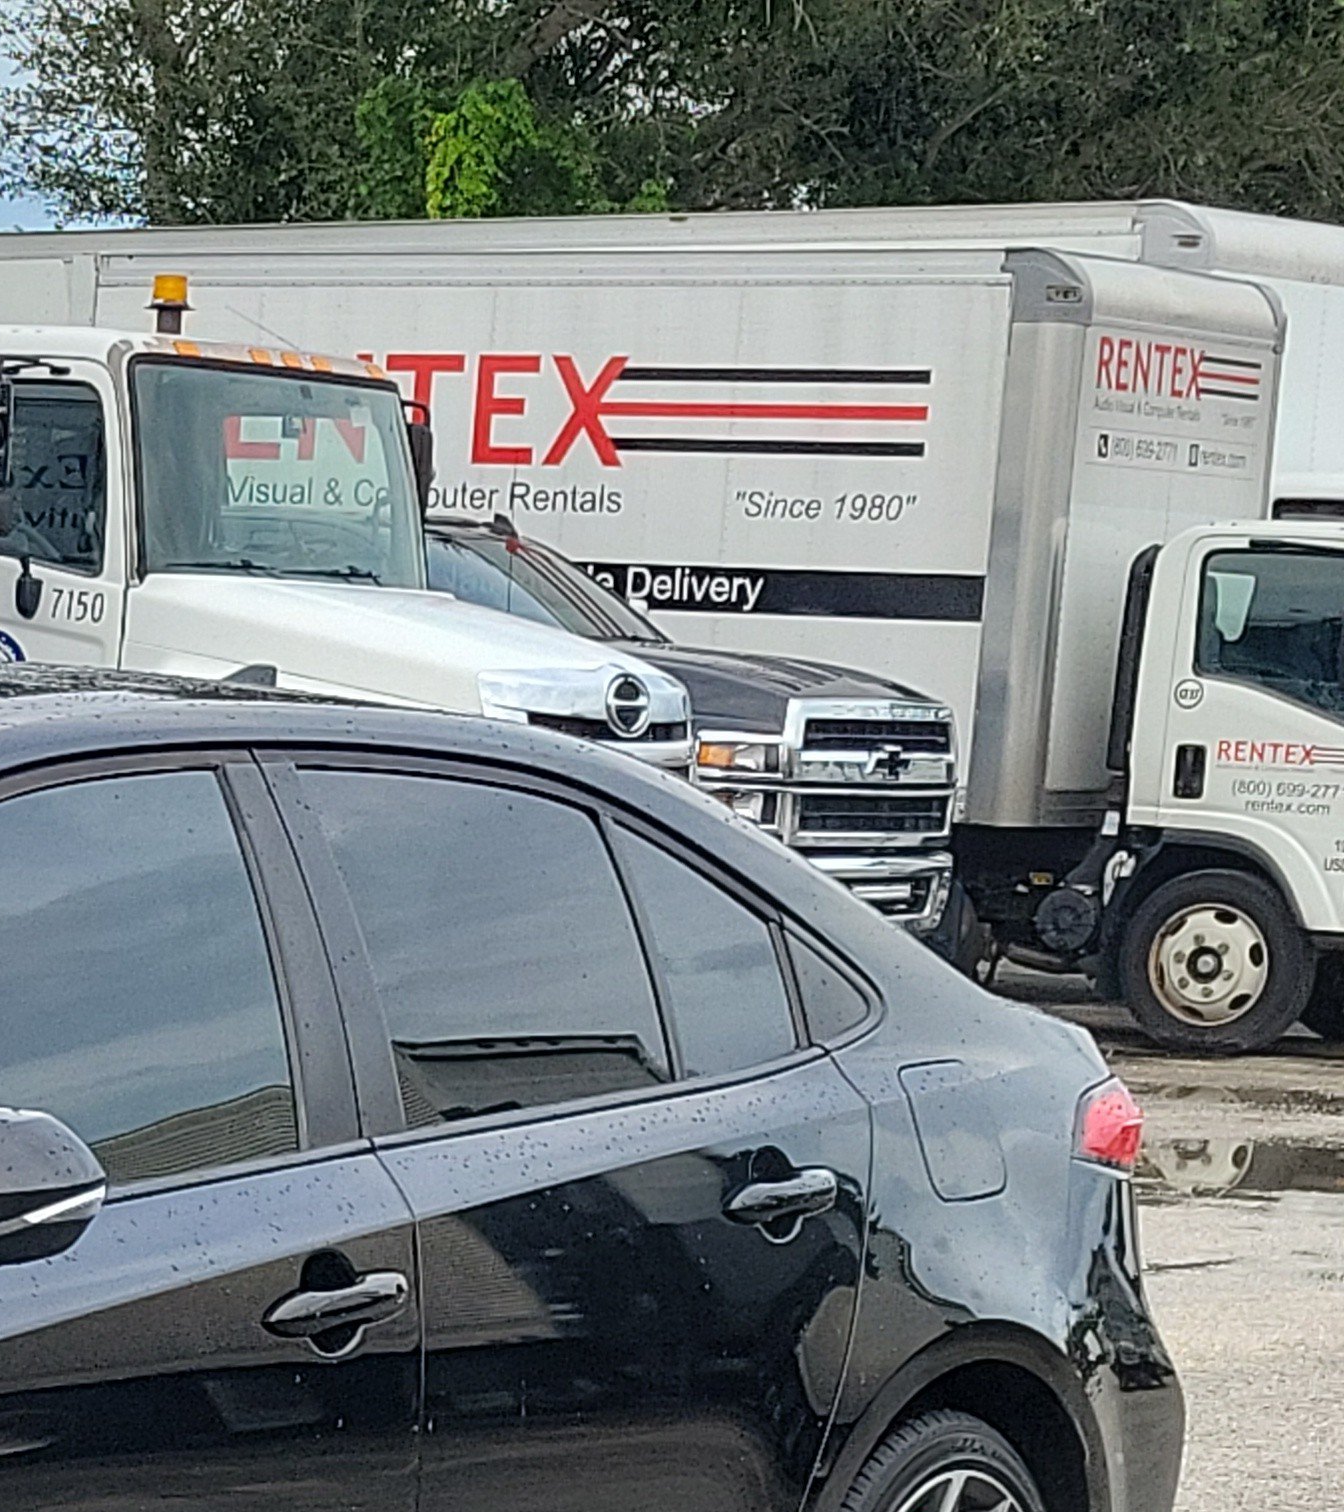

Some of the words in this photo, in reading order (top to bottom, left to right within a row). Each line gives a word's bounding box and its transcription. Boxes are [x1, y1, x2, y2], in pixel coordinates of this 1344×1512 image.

[1095, 336, 1206, 401] RENTEX
[227, 475, 313, 505] Visual
[323, 477, 343, 506] &
[353, 478, 500, 511] Couter
[508, 481, 623, 513] Rentals
[735, 490, 822, 519] "Since
[834, 493, 918, 521] 1980"
[50, 587, 105, 623] 7150
[625, 565, 765, 612] Delivery
[1216, 740, 1315, 765] RENTEX
[1231, 780, 1272, 799] (800)
[1276, 781, 1344, 800] 699-277
[1244, 799, 1331, 816] rentex.com
